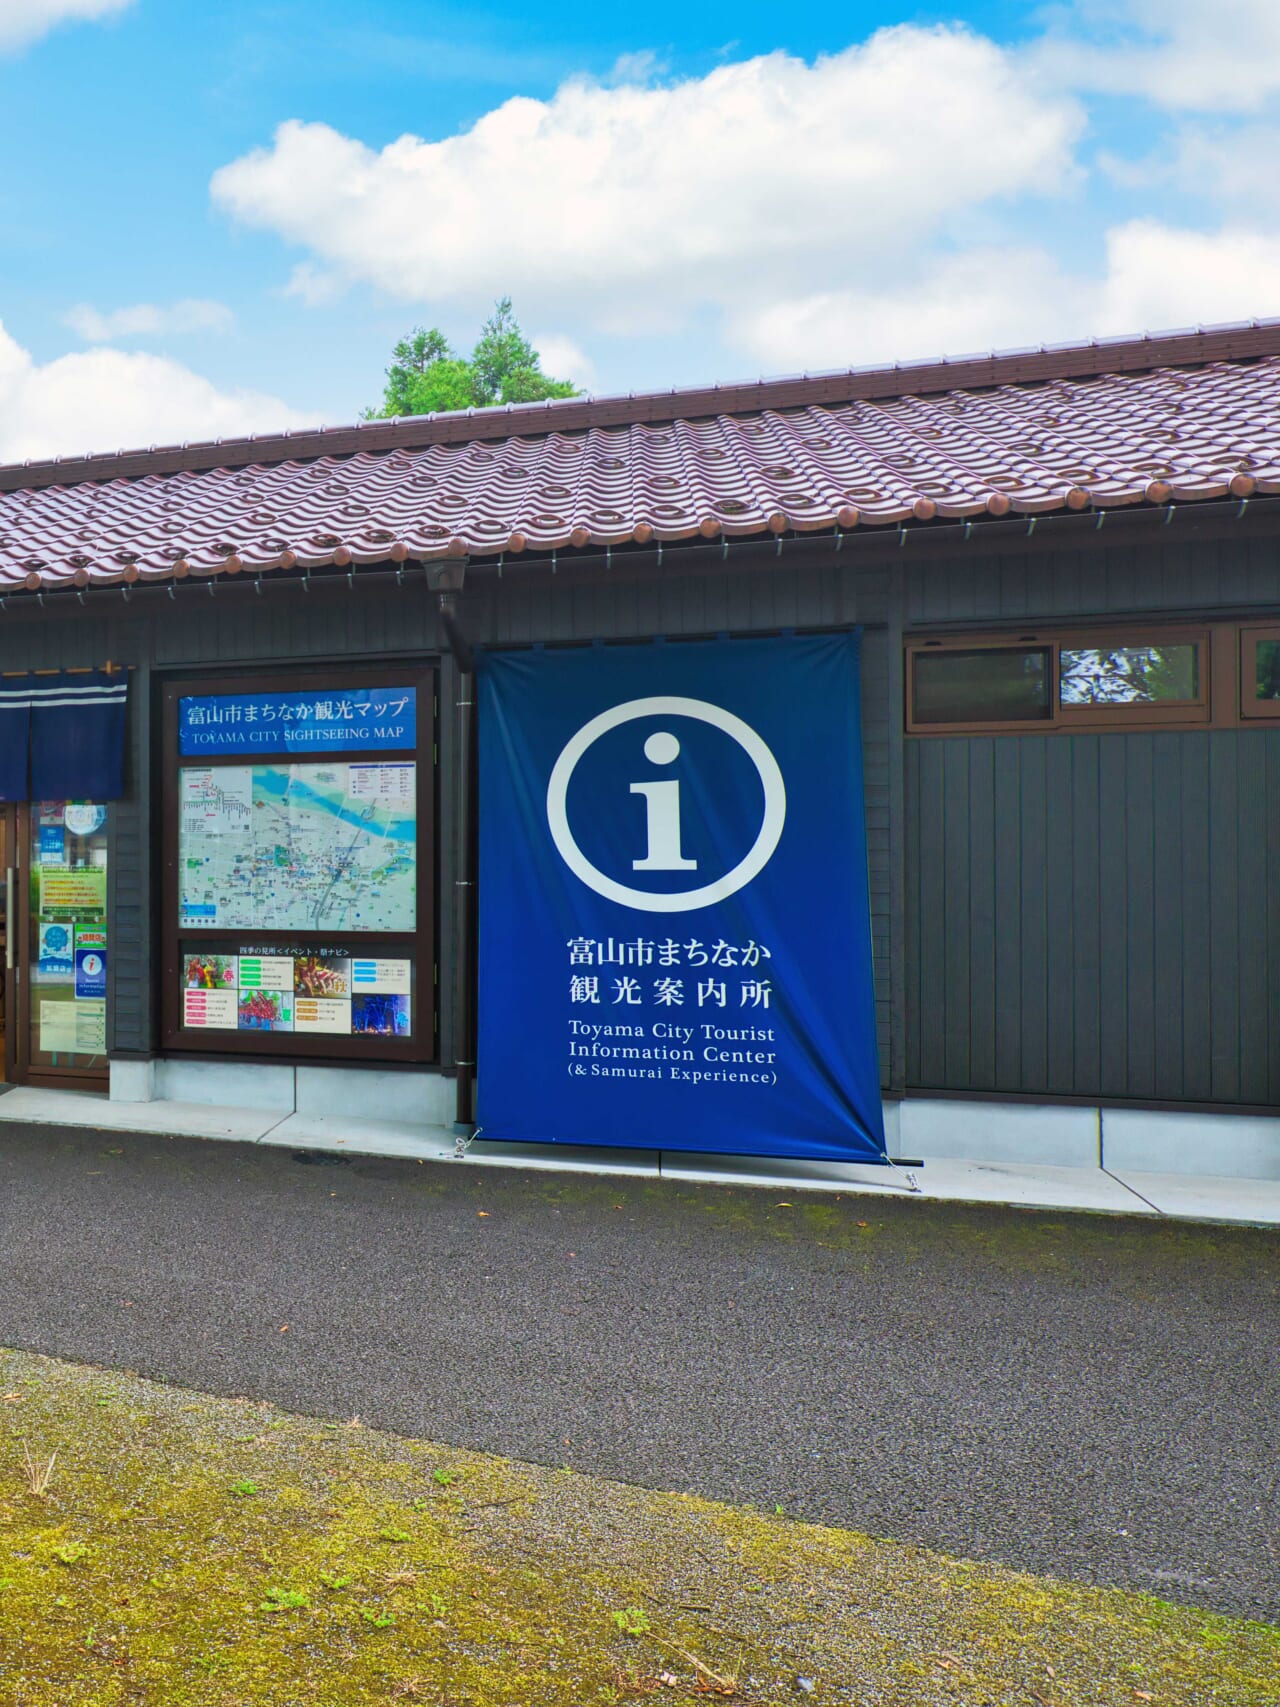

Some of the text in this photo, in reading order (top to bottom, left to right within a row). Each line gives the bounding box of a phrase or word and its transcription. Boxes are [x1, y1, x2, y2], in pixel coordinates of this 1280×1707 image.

[187, 697, 409, 725] 富山市まちなか観光マップ
[192, 727, 404, 744] TOYAMA CITY SIGHTSEEING MAP
[567, 937, 771, 966] 富山市まちなか
[223, 969, 234, 983] 春
[569, 974, 773, 1008] 観光案内所
[568, 1020, 775, 1044] Toyama City Tourist
[568, 1041, 776, 1064] Information Center
[568, 1062, 777, 1085] (& Samurai Experience)
